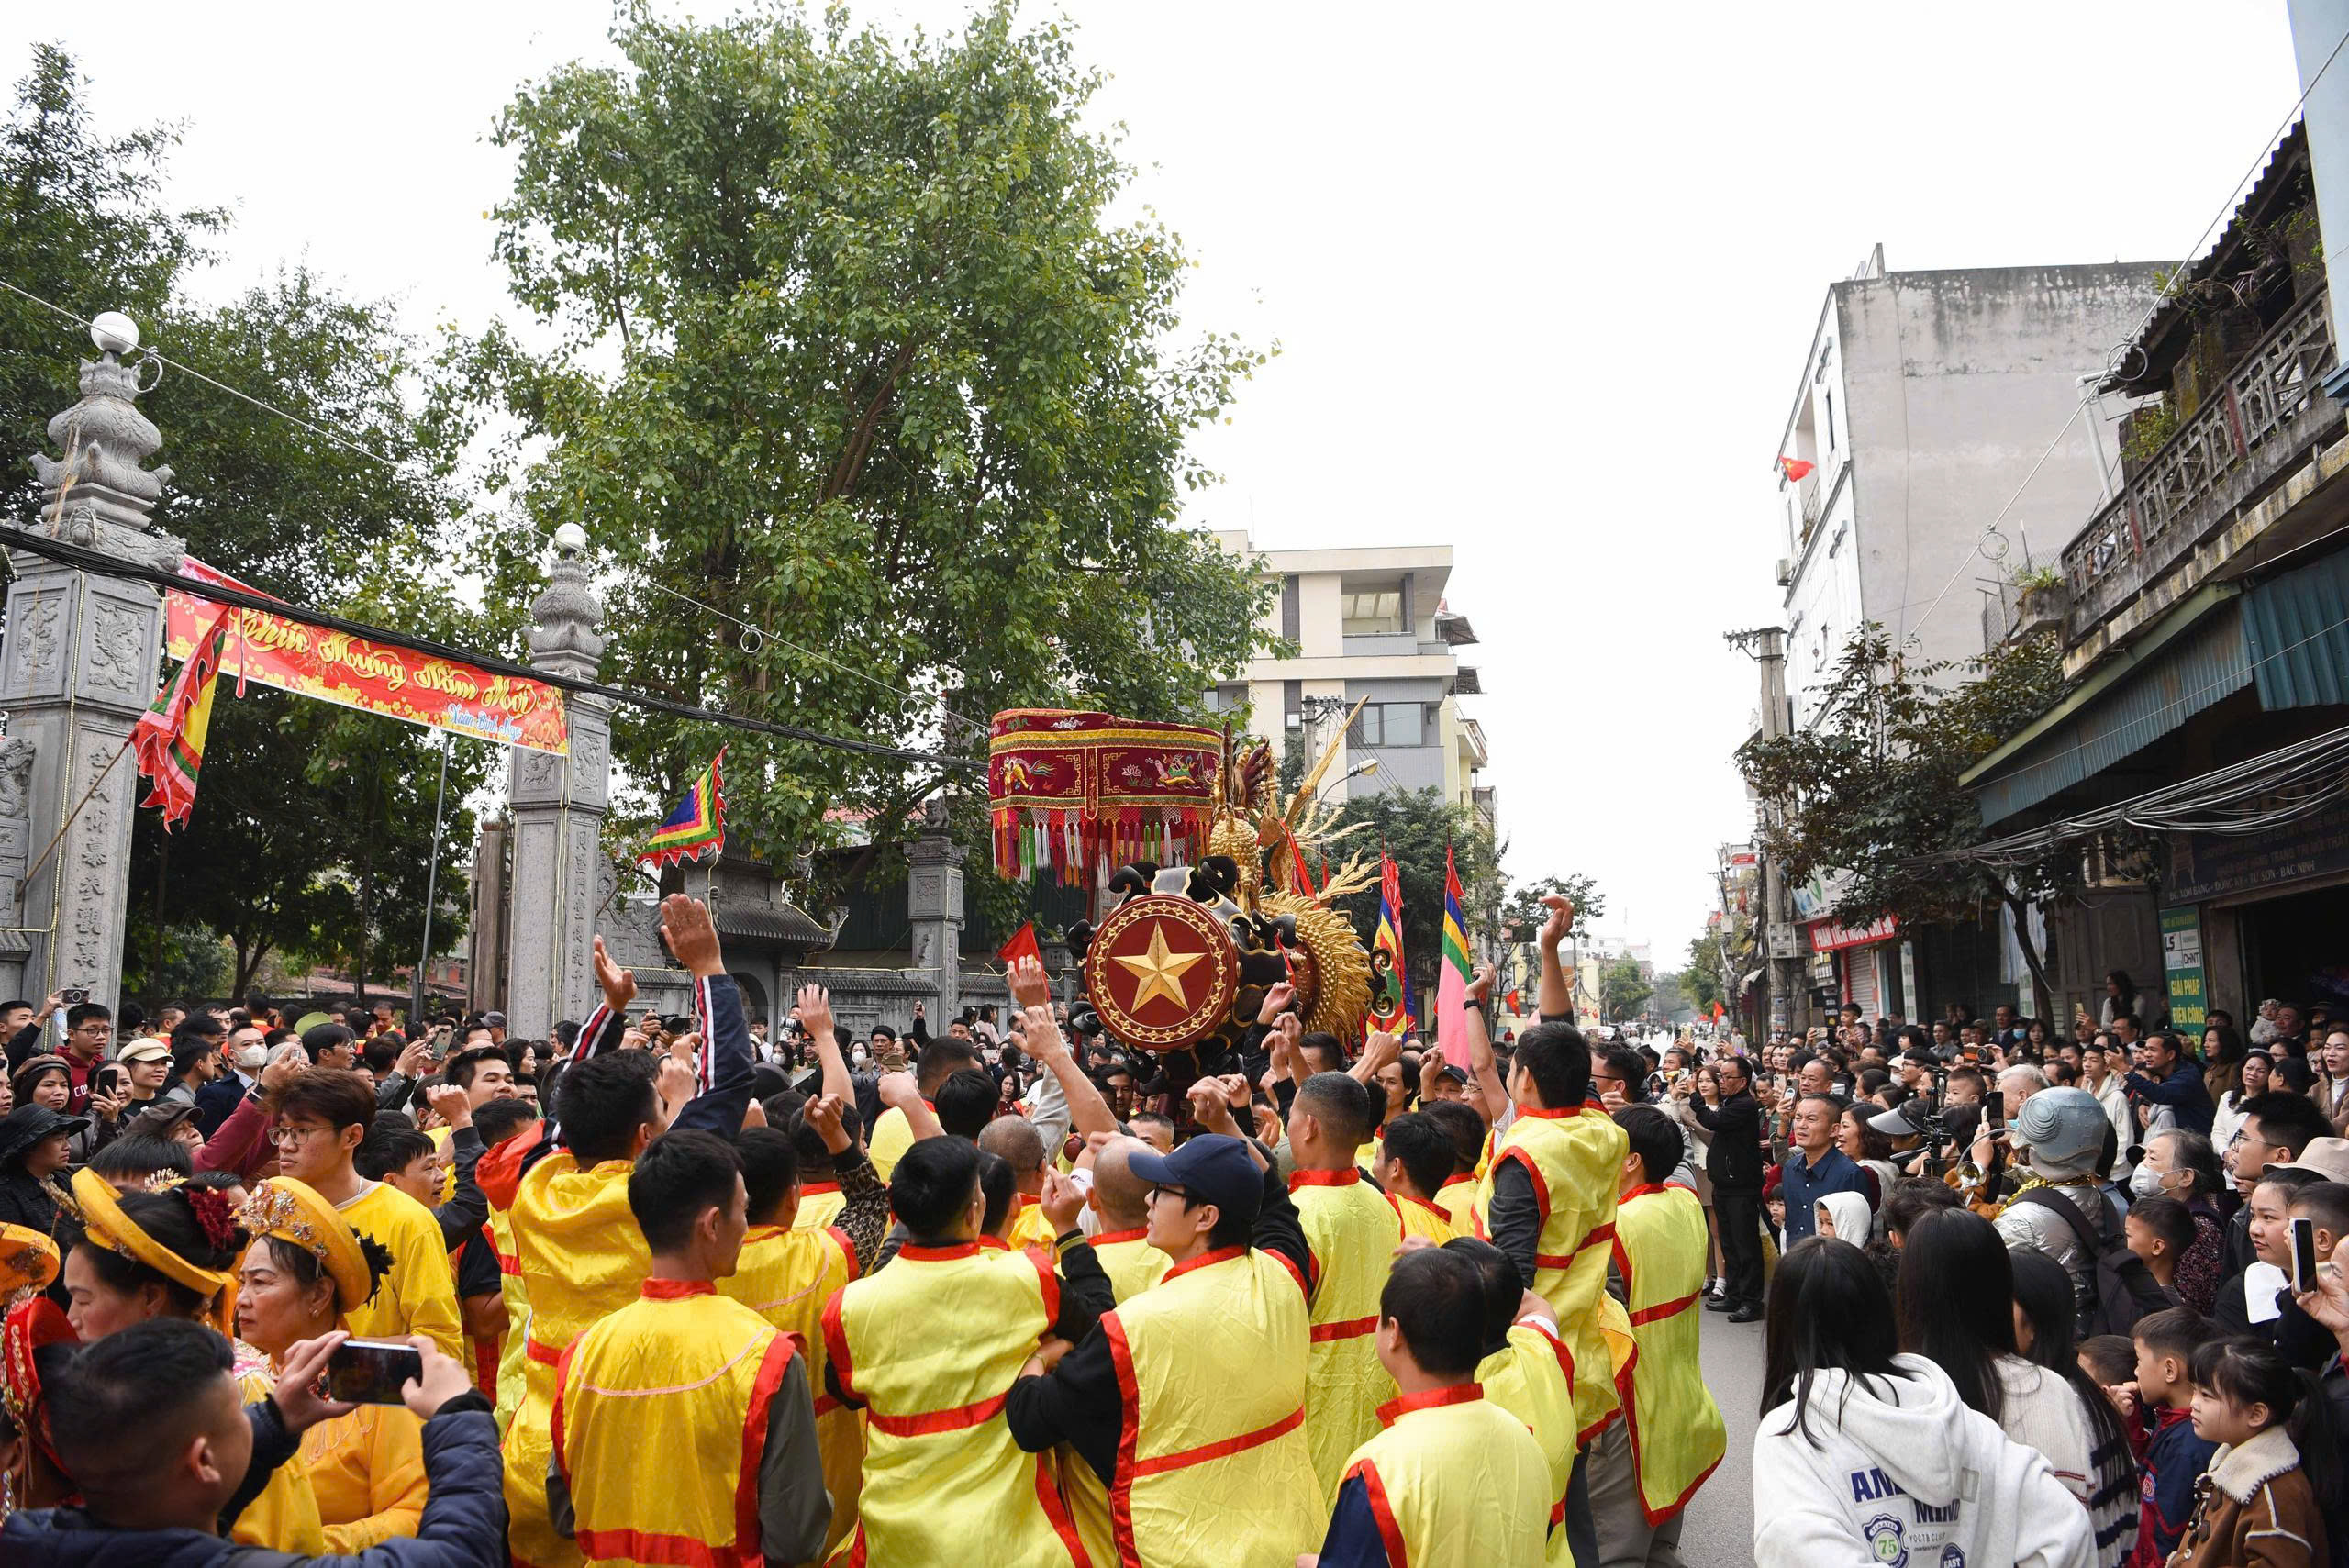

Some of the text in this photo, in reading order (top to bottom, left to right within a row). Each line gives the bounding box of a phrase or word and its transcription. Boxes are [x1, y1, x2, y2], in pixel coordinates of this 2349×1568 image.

[317, 632, 407, 692] Mừng
[413, 660, 479, 700] Năm
[481, 674, 537, 719] Mới
[1878, 1539, 1898, 1556] 75
